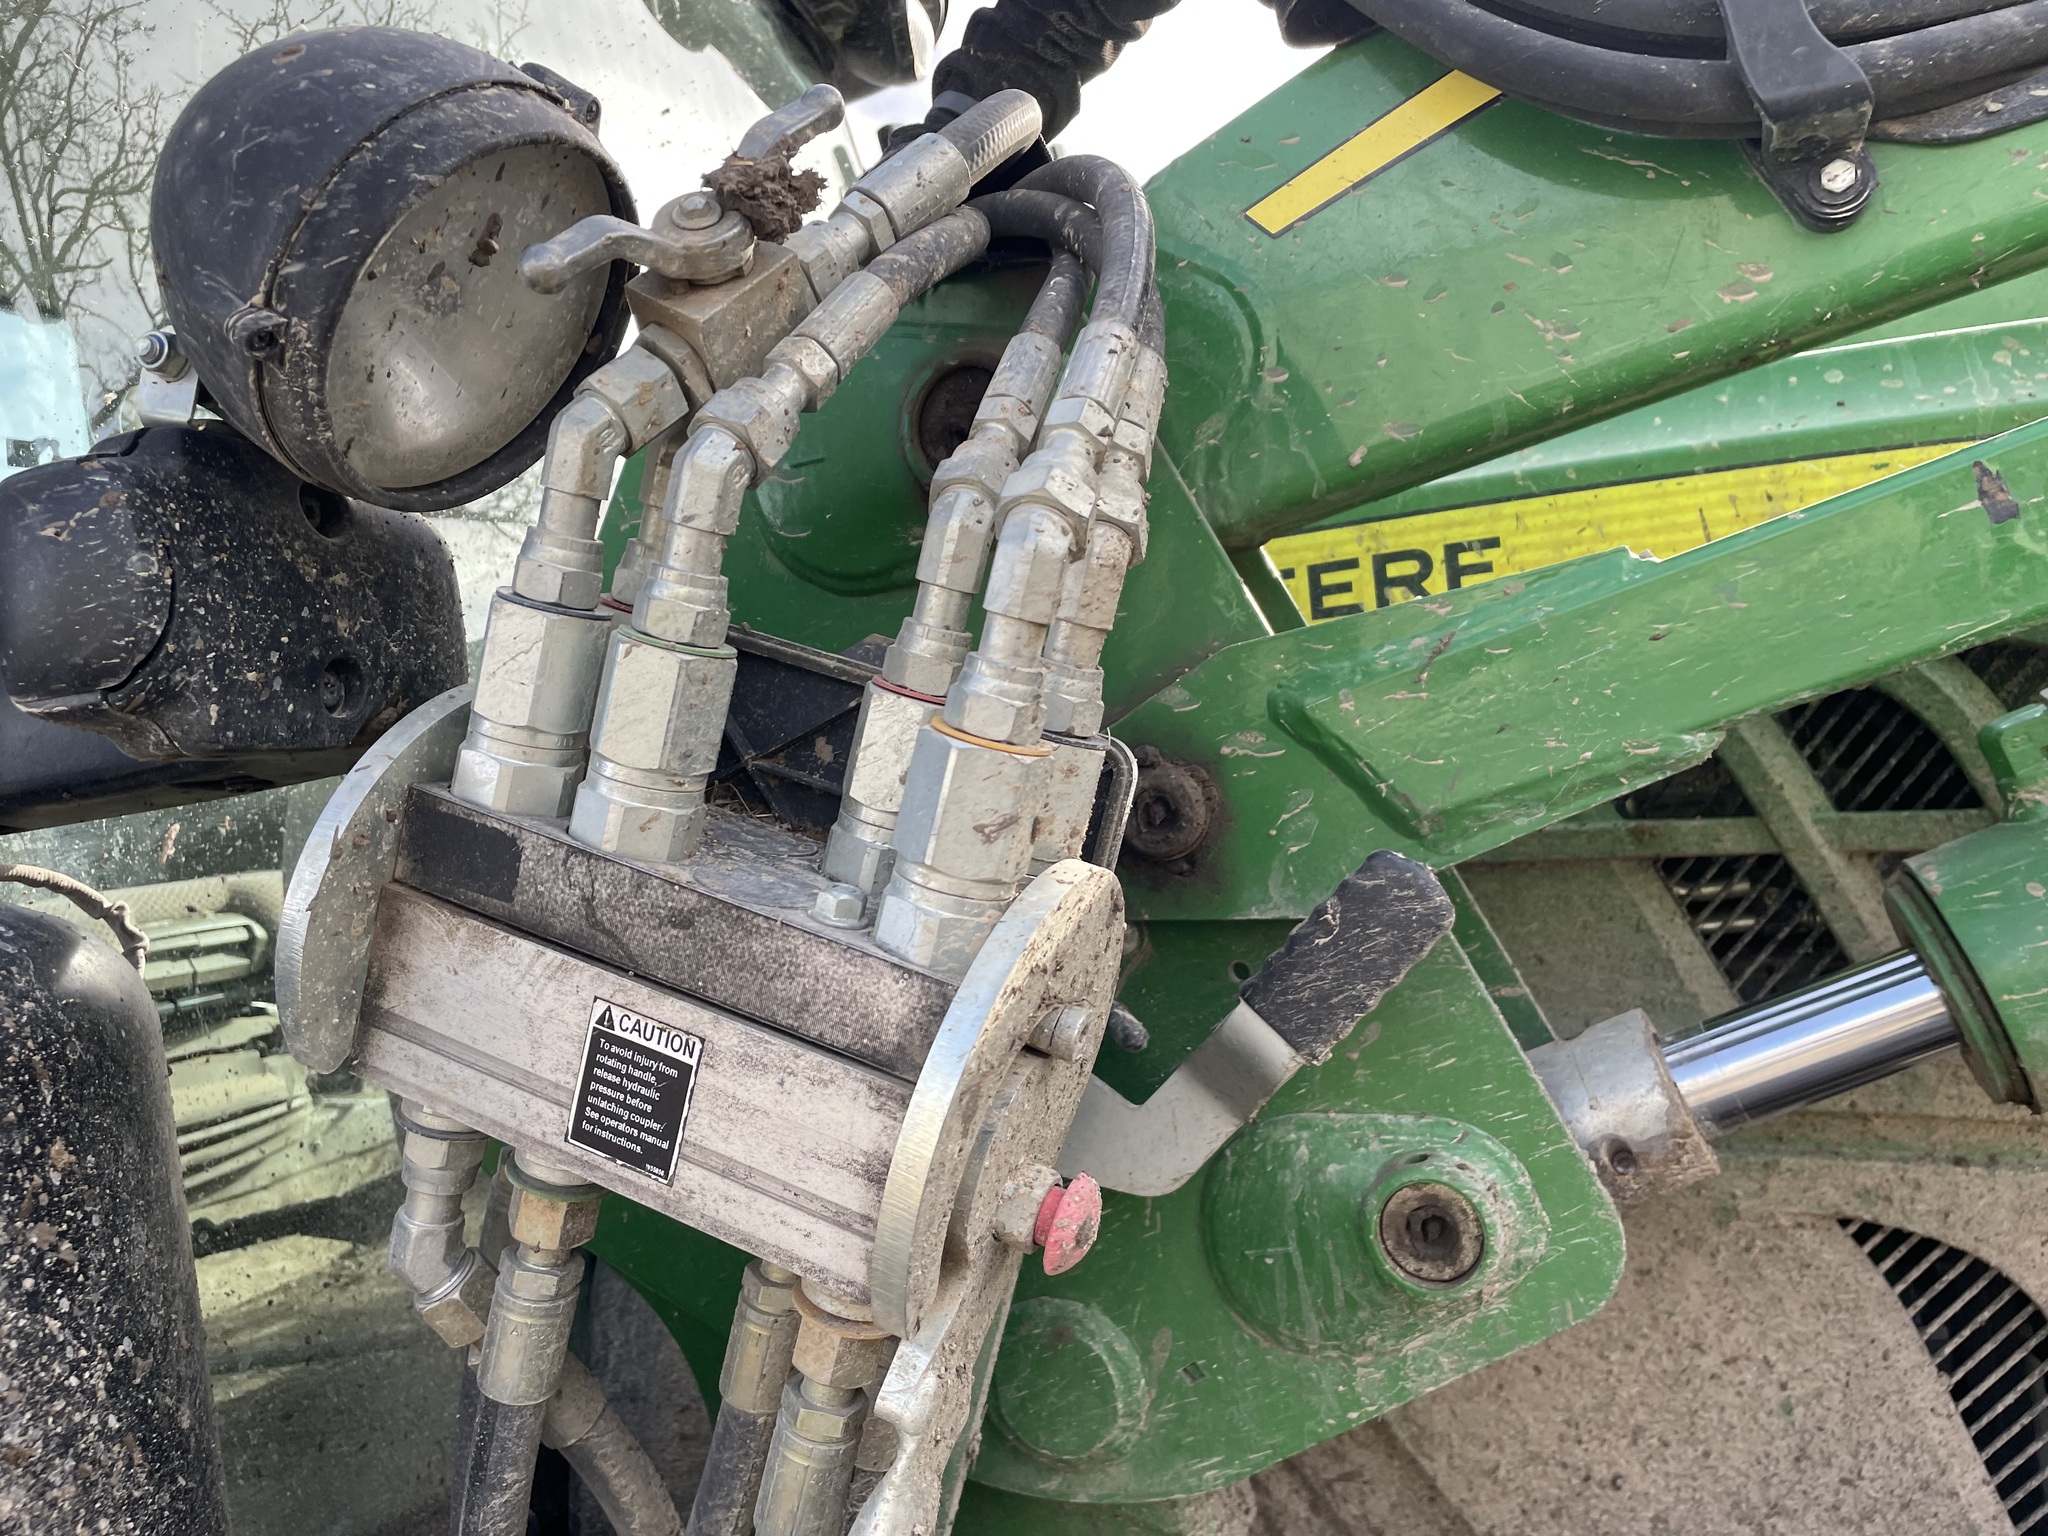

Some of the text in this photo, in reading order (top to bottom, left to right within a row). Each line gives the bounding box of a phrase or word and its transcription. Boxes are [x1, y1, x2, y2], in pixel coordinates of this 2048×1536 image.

[619, 1013, 695, 1058] CAUTION
[595, 1053, 657, 1086] rotating handle,
[599, 1037, 678, 1078] To avoid injury from
[589, 1081, 652, 1112] pressure before
[592, 1067, 660, 1100] release hydraulic
[587, 1094, 629, 1120] unlatching
[581, 1119, 642, 1154] for instructions.
[584, 1106, 669, 1149] See operators manual
